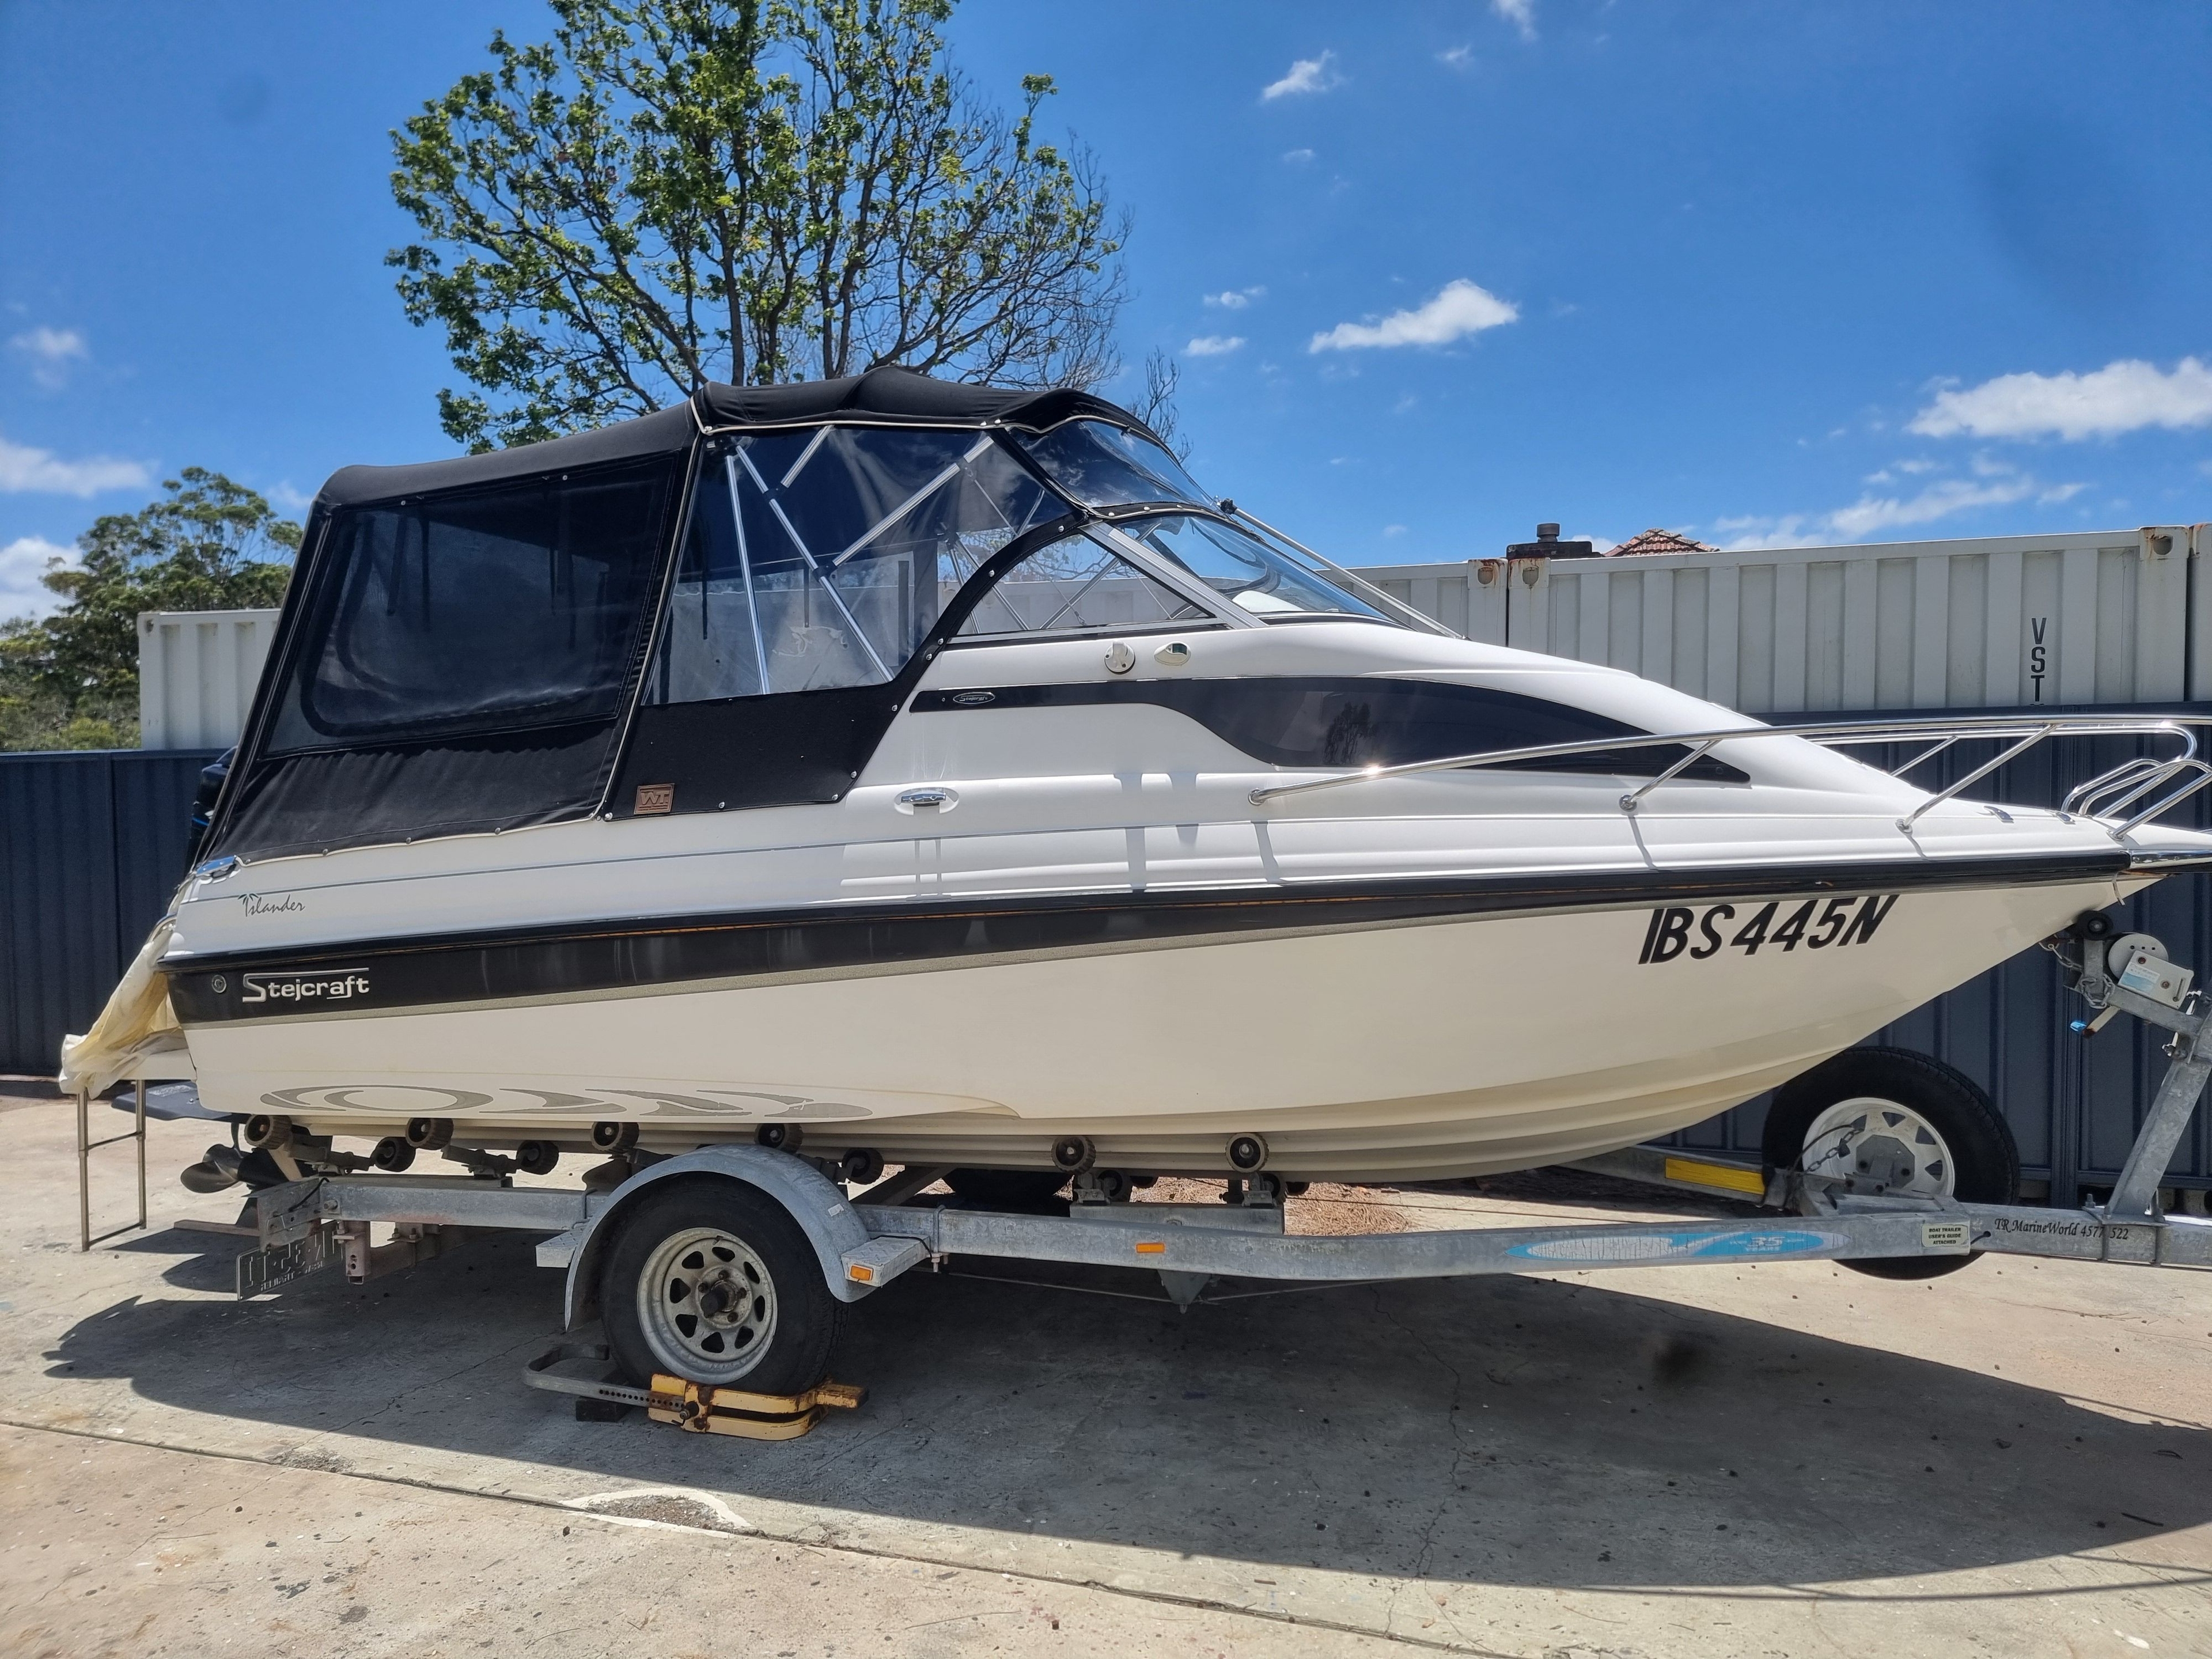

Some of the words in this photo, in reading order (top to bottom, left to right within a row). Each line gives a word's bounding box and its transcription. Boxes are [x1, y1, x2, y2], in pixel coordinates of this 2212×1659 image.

[2030, 617, 2047, 706] VST
[238, 893, 306, 917] Islander
[1638, 894, 1900, 965] IBS445N
[242, 967, 370, 1003] Stejcraft
